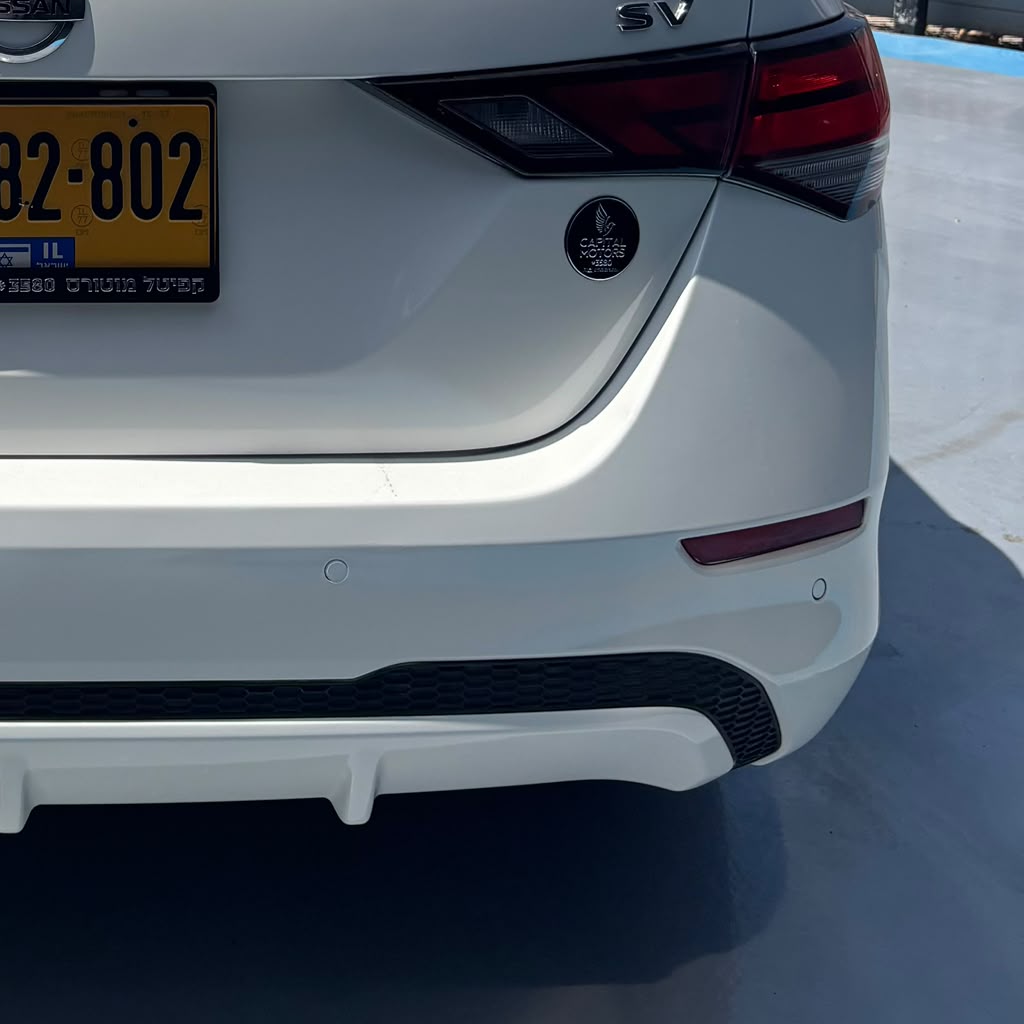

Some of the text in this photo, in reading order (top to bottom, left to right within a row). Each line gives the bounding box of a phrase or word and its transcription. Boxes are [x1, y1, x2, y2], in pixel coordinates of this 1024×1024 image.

[43, 242, 64, 259] IL
[65, 276, 205, 295] קפיטל מוטורס
